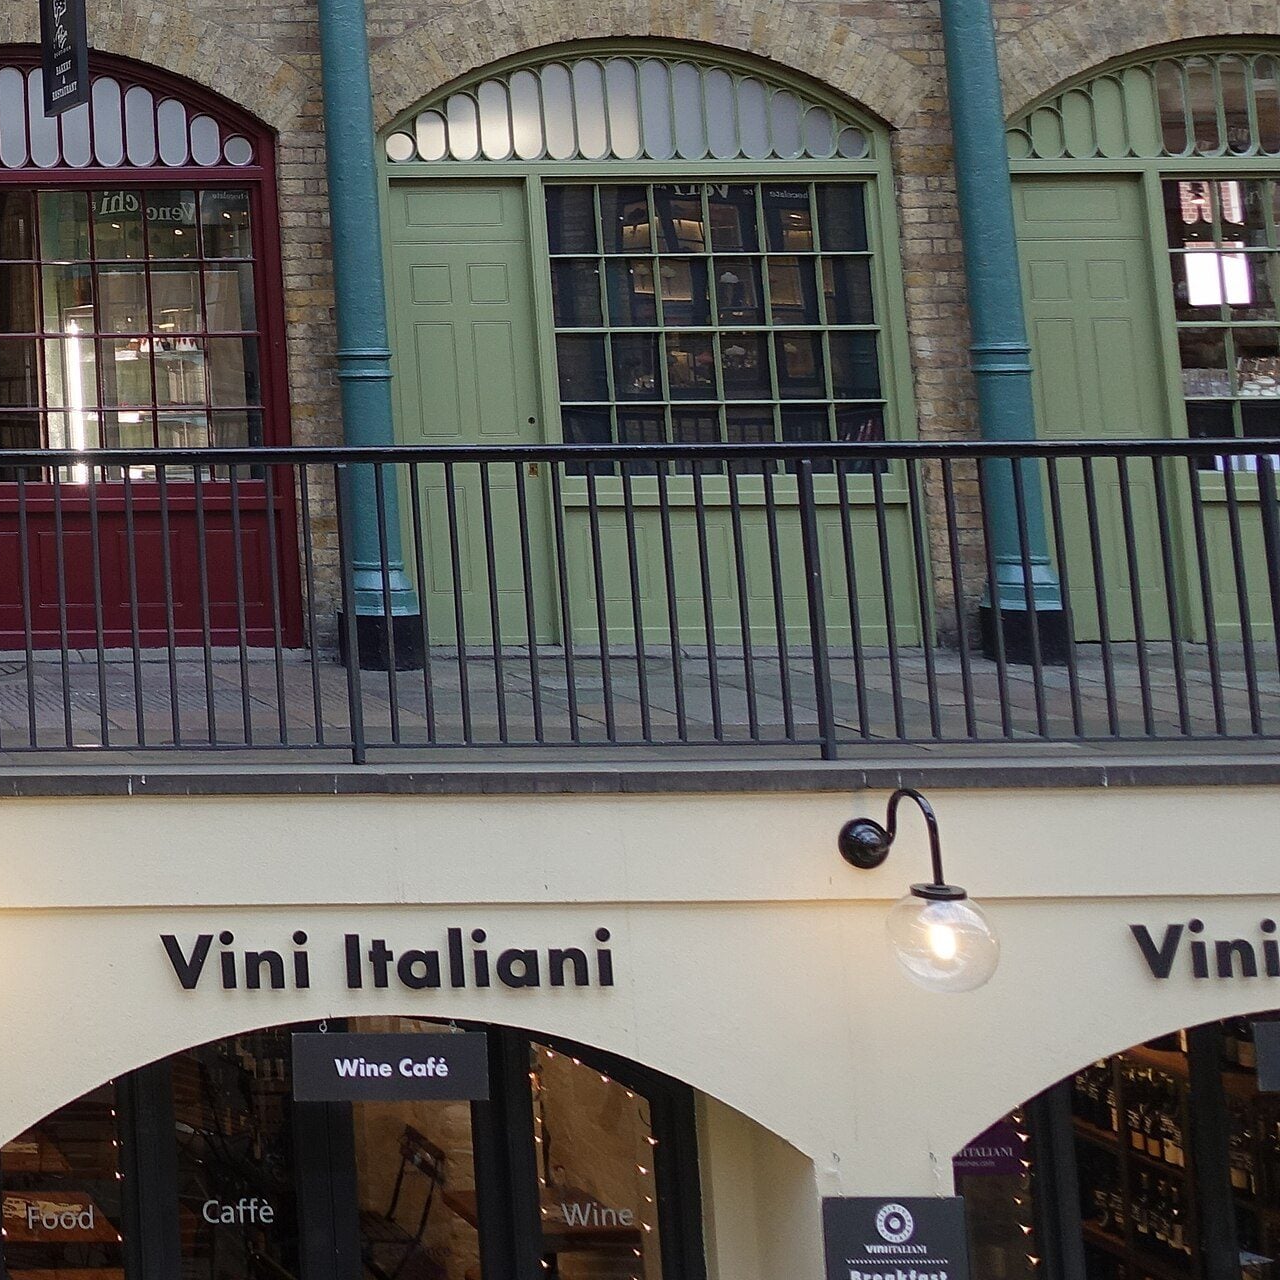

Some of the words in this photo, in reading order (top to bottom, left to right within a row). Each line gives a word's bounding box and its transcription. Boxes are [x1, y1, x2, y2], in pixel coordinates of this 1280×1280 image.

[159, 930, 311, 990] Vini
[344, 927, 615, 989] Italiani
[1128, 918, 1280, 979] Vini
[334, 1058, 392, 1078] Wine
[399, 1057, 449, 1078] Café
[26, 1205, 95, 1231] Food
[202, 1198, 274, 1225] Caffè
[561, 1202, 634, 1227] Wine
